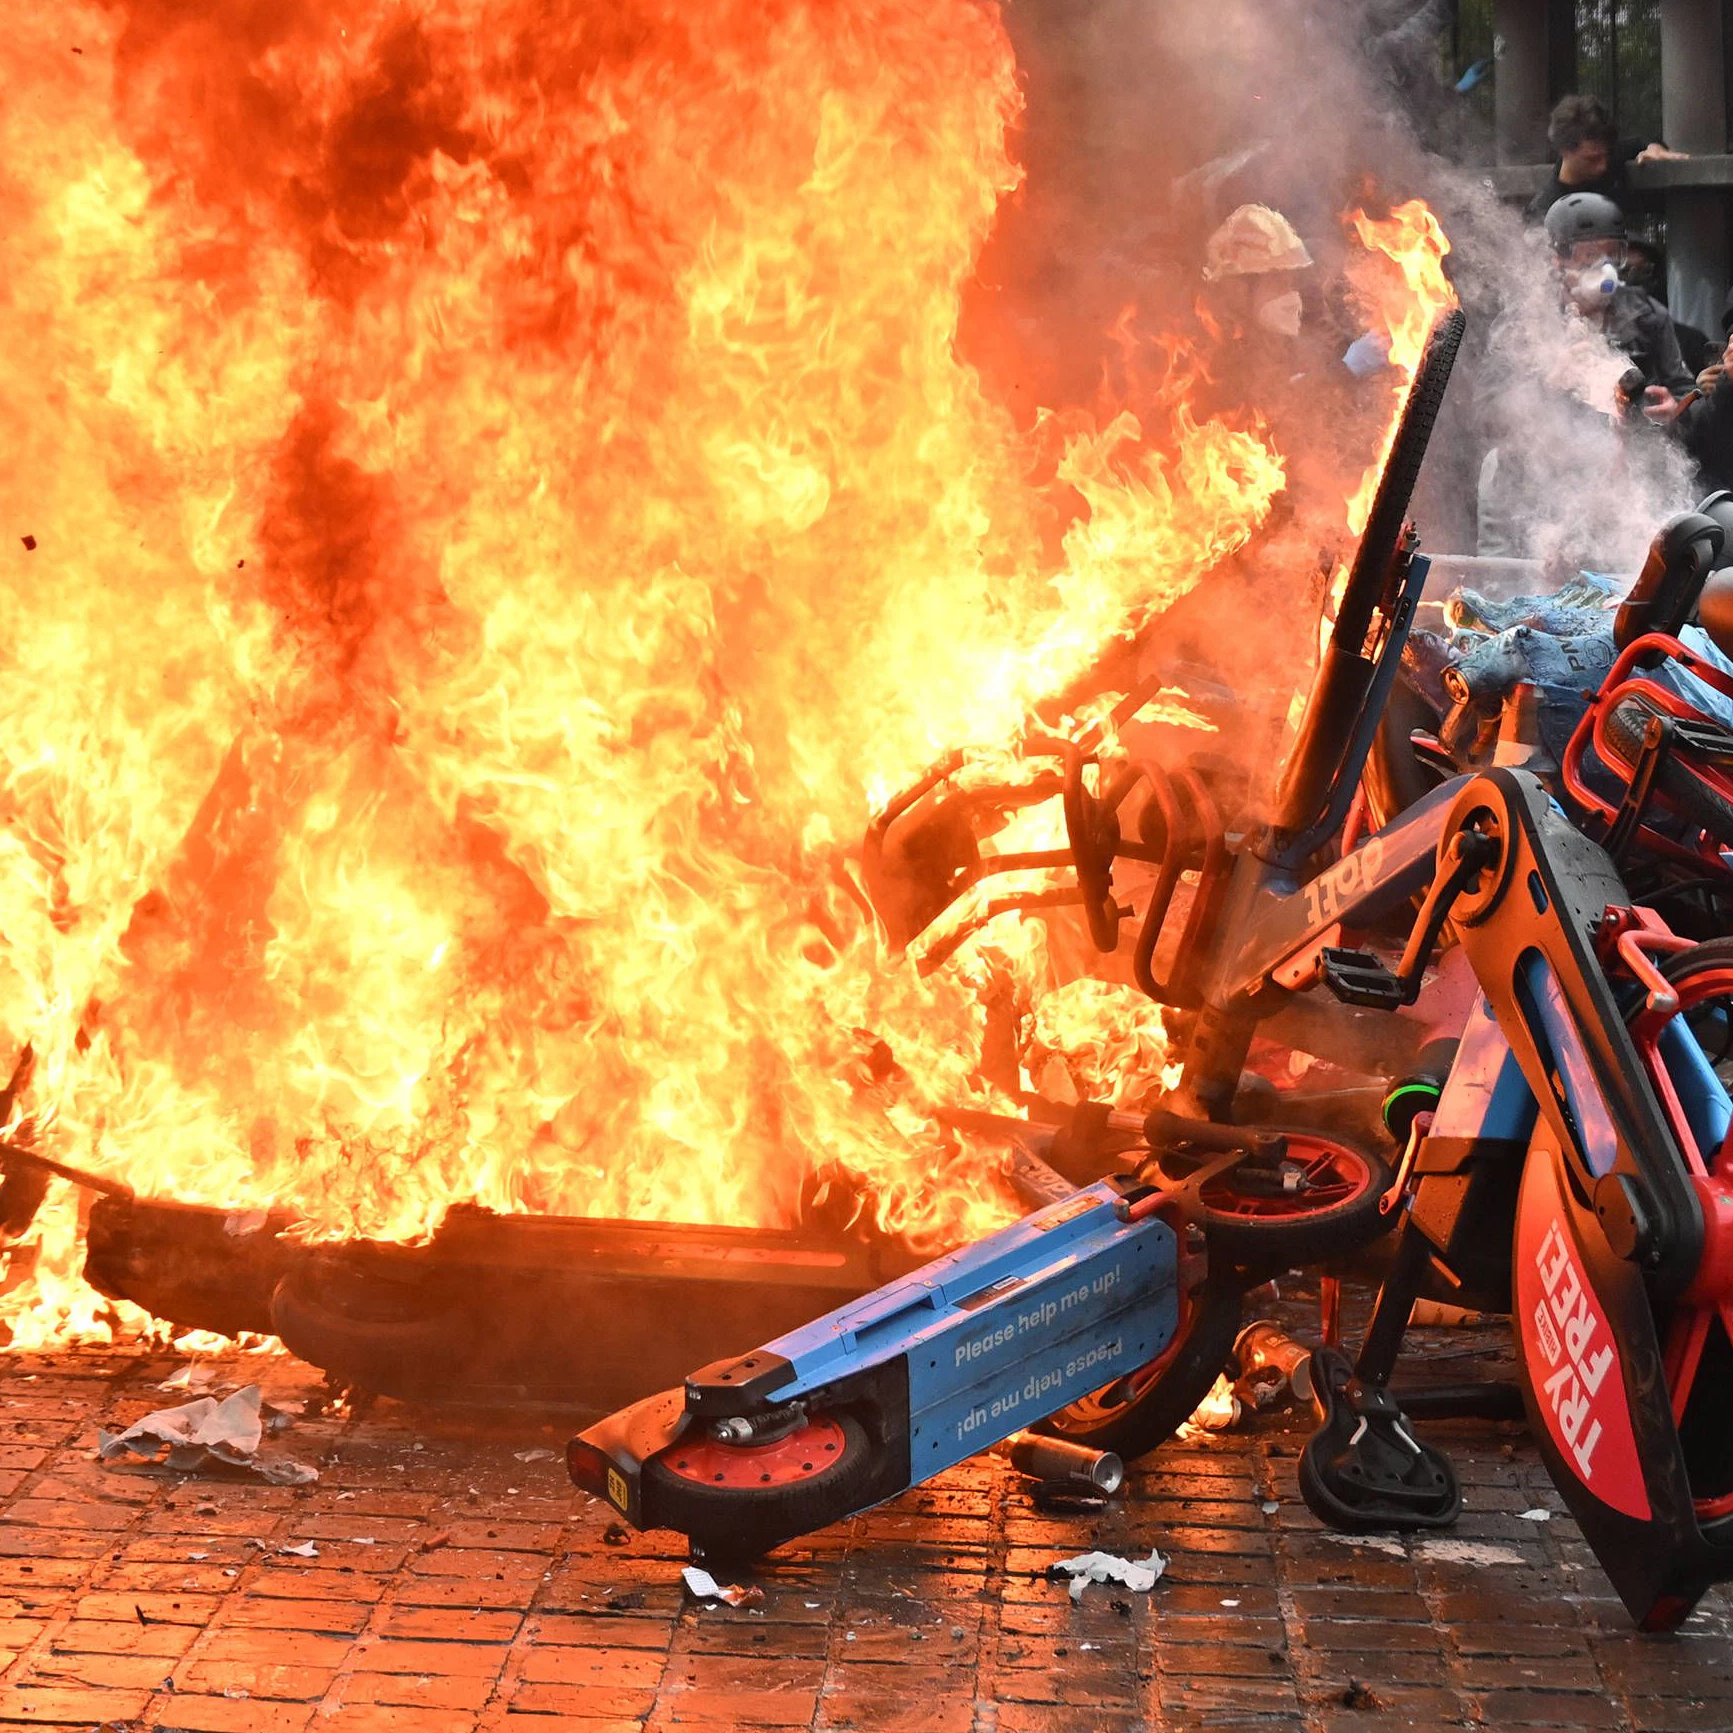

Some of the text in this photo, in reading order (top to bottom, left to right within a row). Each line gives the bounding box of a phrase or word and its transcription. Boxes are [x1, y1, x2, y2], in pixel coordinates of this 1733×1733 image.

[955, 1323, 1015, 1367] Please
[1018, 1303, 1057, 1333] help
[1061, 1286, 1089, 1312] me
[1093, 1264, 1120, 1294] up!
[1536, 1219, 1615, 1480] TRY FREE!
[956, 1337, 1123, 1441] Please help me up!
